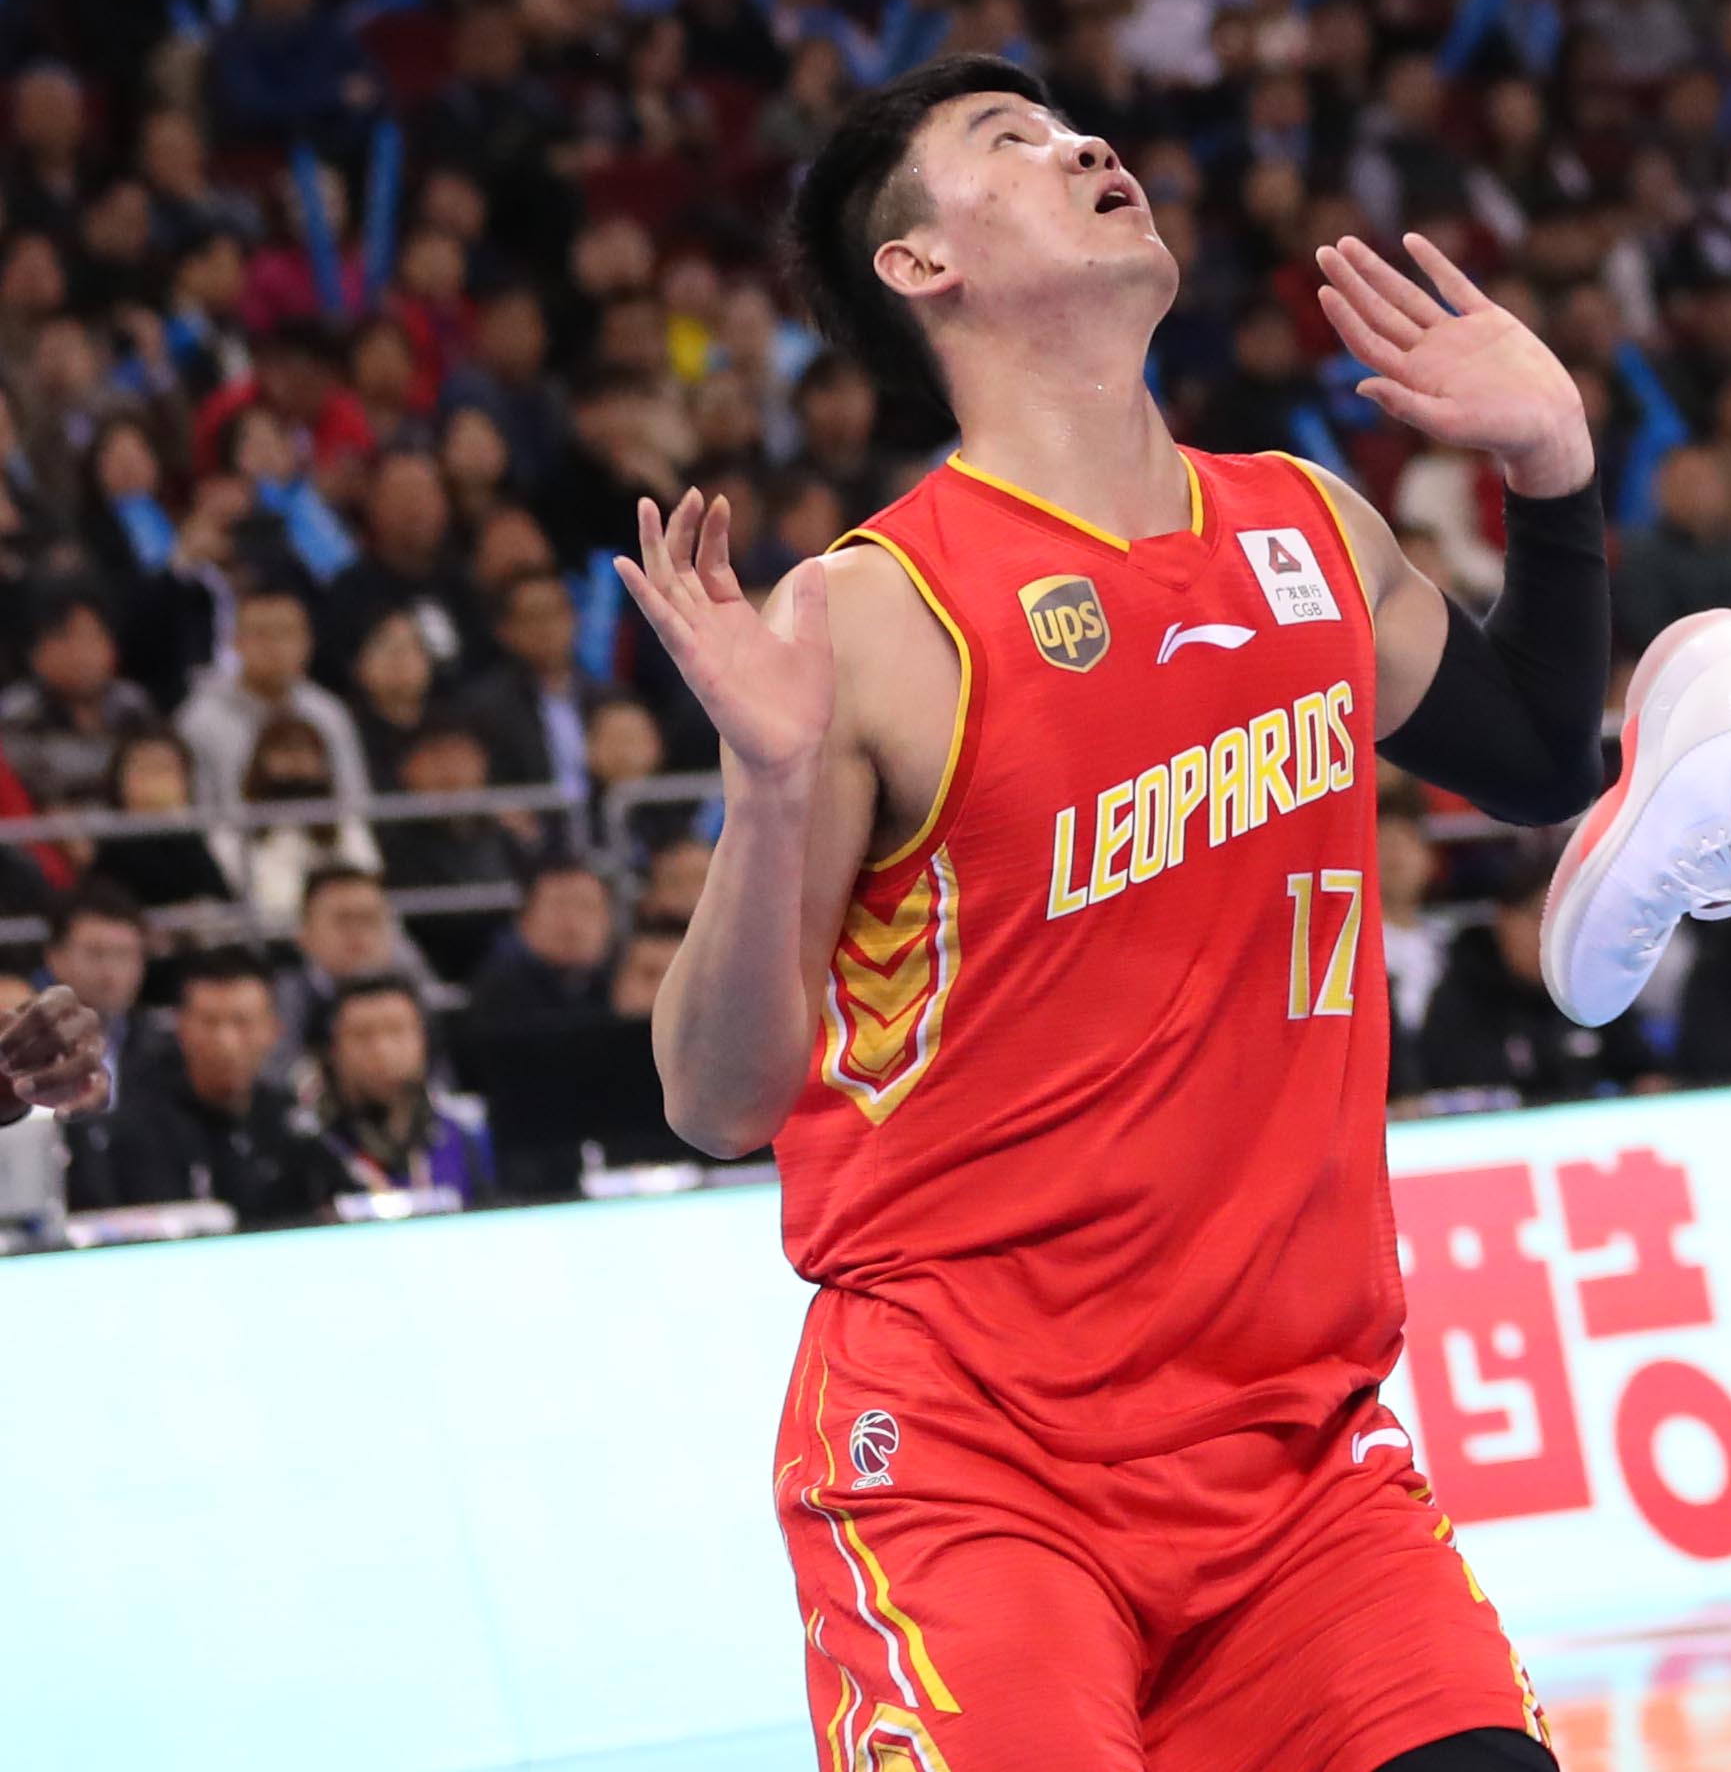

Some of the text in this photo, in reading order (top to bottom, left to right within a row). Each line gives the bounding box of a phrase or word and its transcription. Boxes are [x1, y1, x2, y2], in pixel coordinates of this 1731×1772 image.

[1032, 601, 1103, 659] ups
[1292, 602, 1322, 618] CGB
[1047, 680, 1354, 919] LEOPARDS
[1287, 870, 1363, 1019] 17
